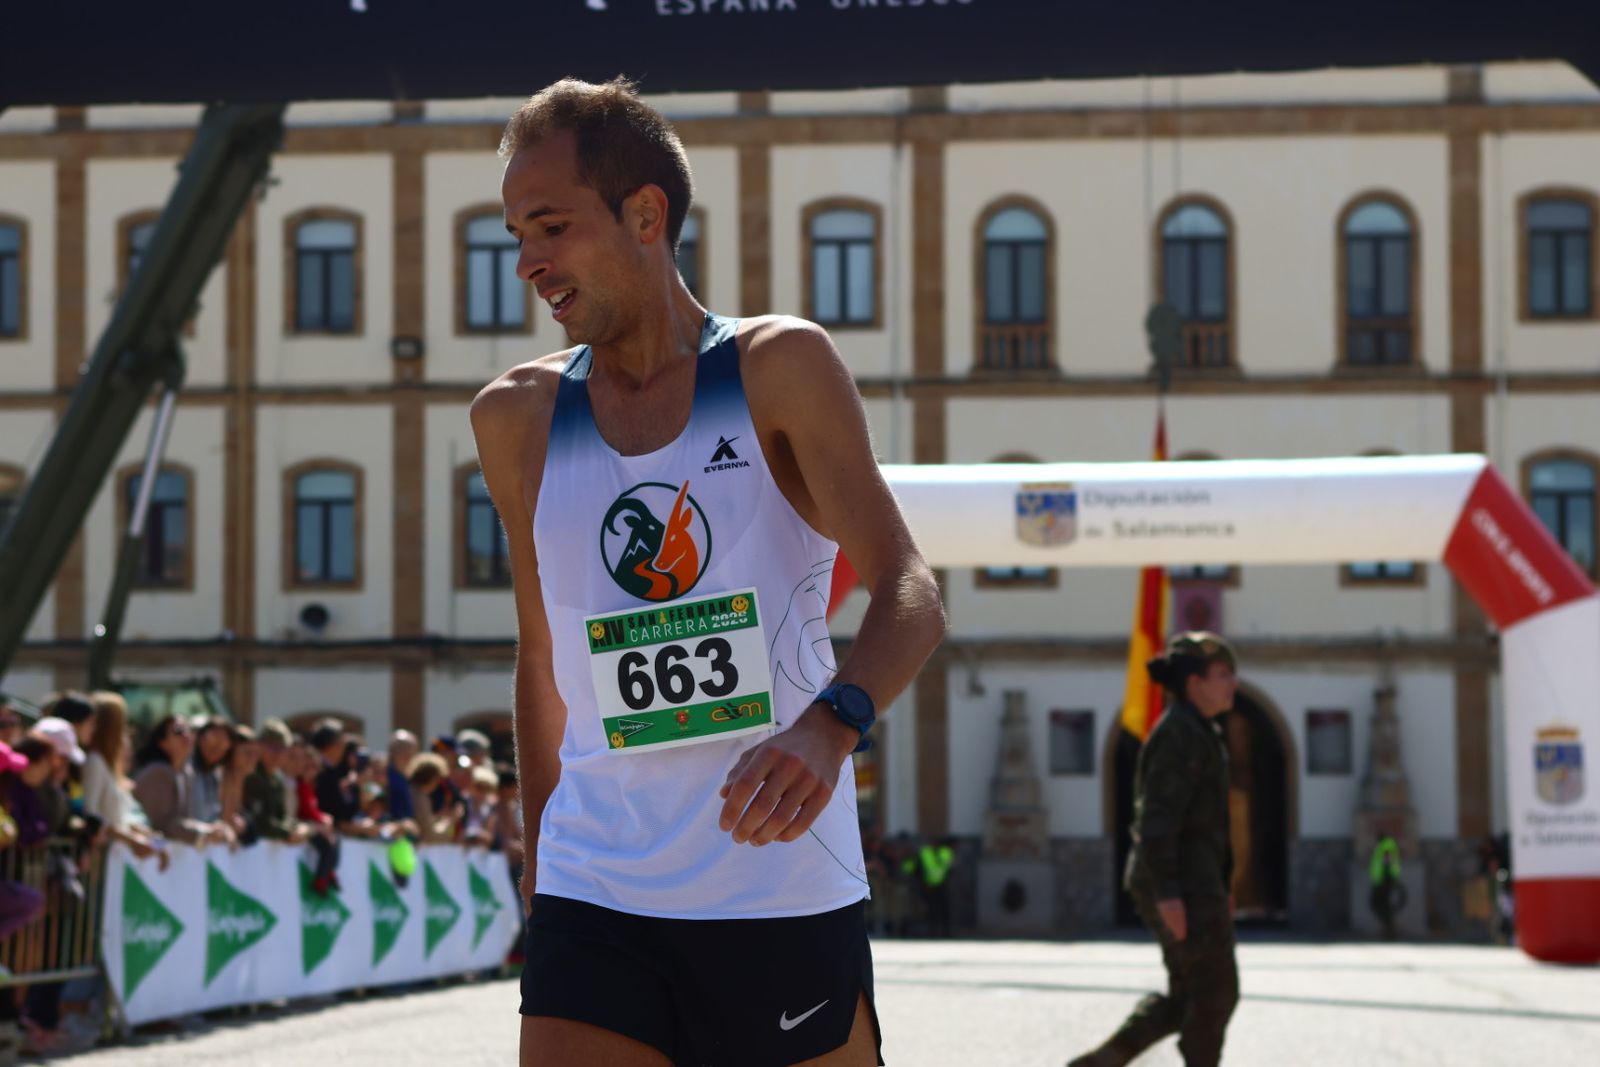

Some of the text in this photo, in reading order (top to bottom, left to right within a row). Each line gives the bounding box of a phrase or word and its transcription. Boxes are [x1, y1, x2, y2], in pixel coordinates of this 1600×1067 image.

[704, 460, 750, 473] EVERNYA
[669, 597, 744, 621] FERNAN
[630, 617, 708, 642] CARRERA
[617, 637, 739, 710] 663
